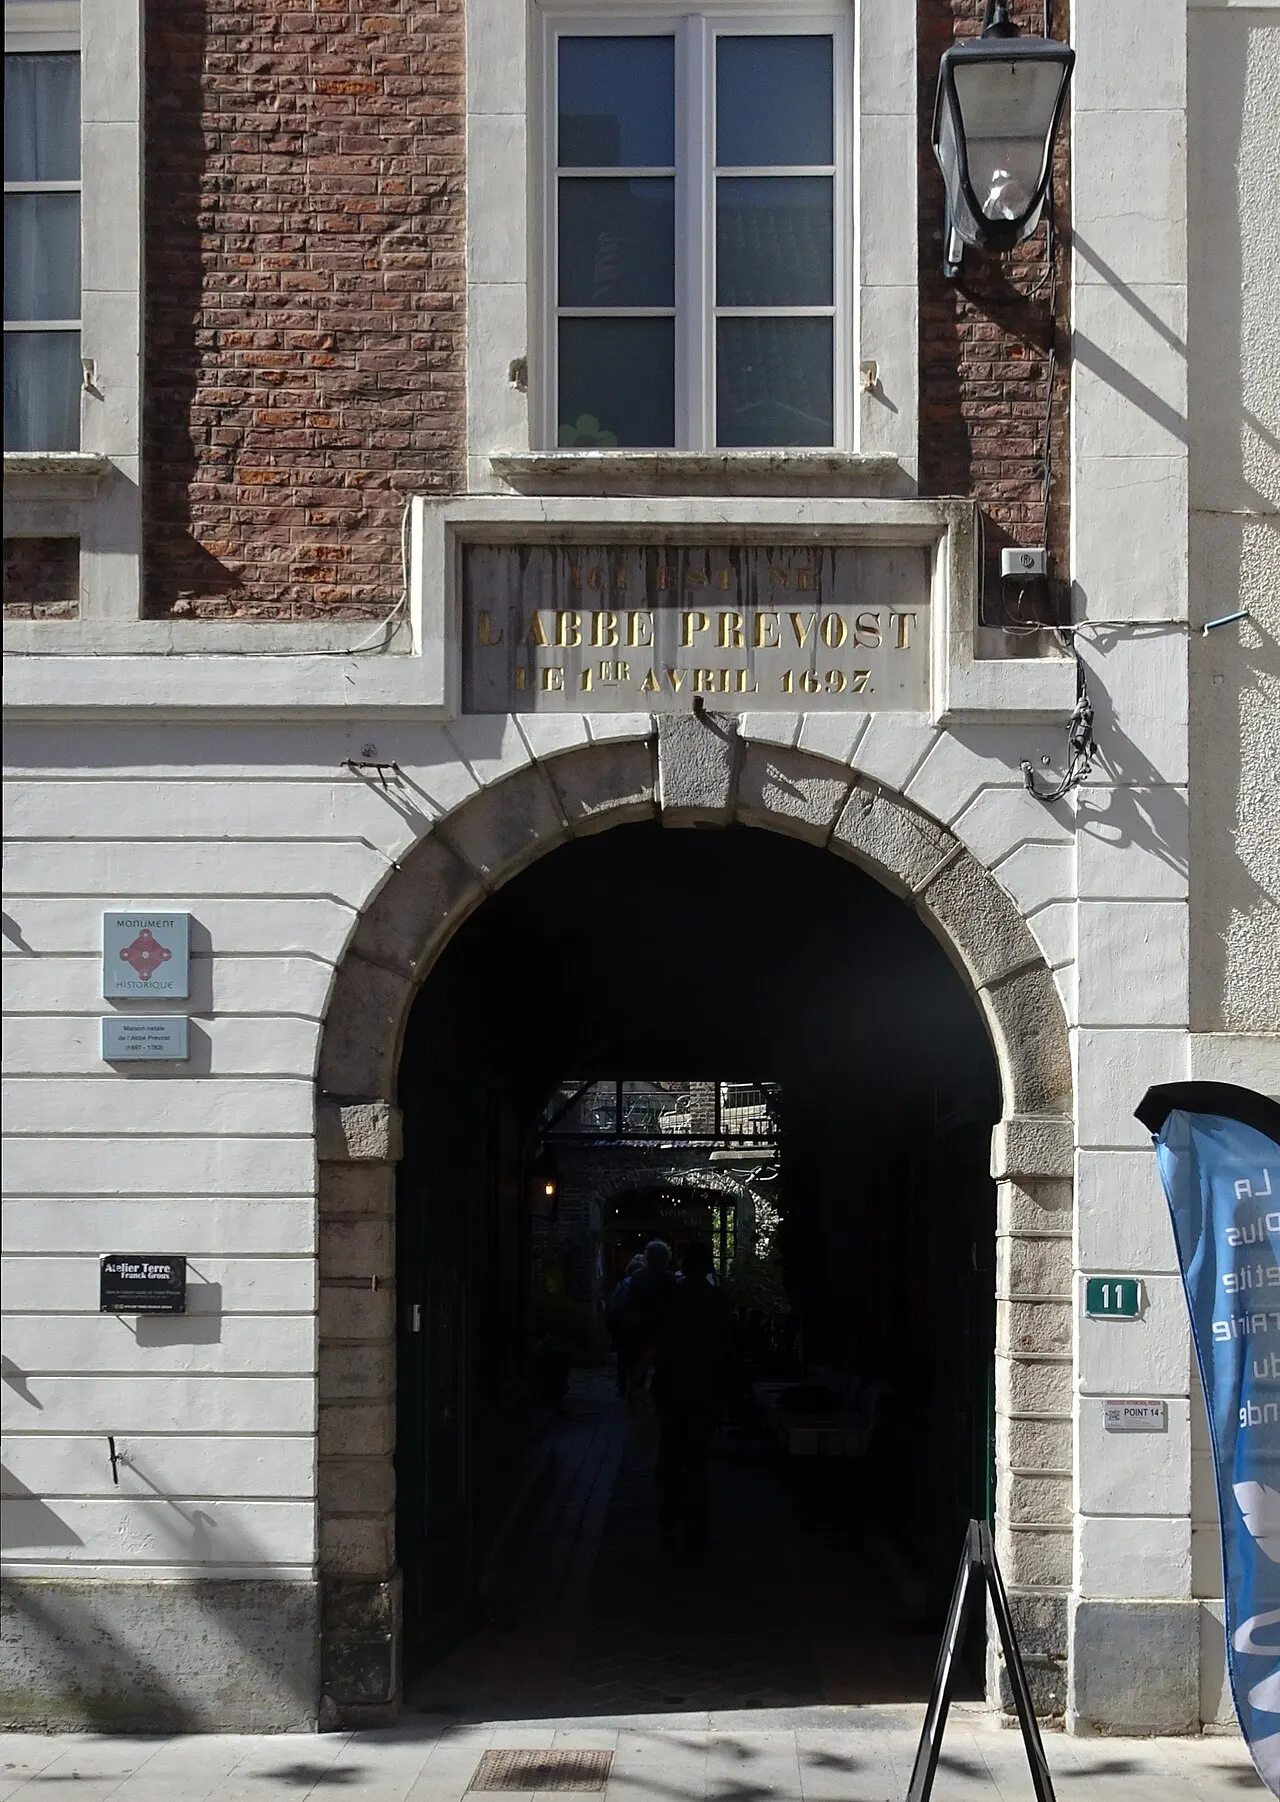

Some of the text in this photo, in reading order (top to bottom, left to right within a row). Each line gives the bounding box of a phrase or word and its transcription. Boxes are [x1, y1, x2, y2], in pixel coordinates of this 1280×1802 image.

[679, 610, 918, 649] PREVOST
[638, 667, 759, 693] AVRIL
[116, 920, 175, 929] MONUMENT
[115, 981, 174, 990] HISTORIQUE
[105, 1263, 171, 1273] Atelier Terre
[1101, 1284, 1122, 1309] 11
[1124, 1408, 1159, 1416] POINT 14
